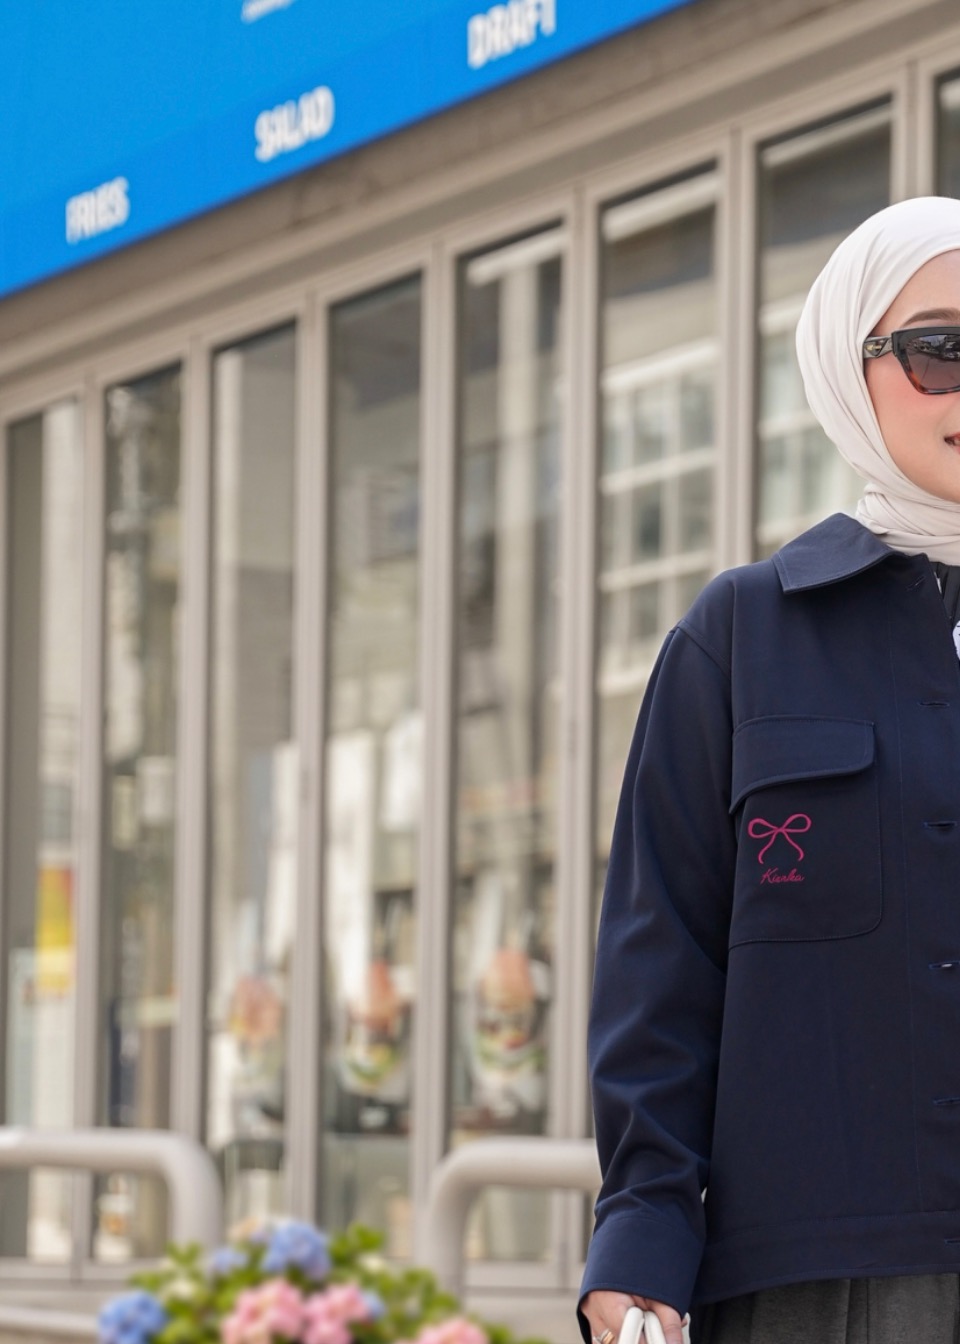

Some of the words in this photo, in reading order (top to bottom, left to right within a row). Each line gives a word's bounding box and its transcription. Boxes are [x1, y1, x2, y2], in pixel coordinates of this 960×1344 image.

[467, 0, 557, 70] DRAFT
[255, 85, 335, 163] SALAD
[66, 176, 130, 245] FRIES
